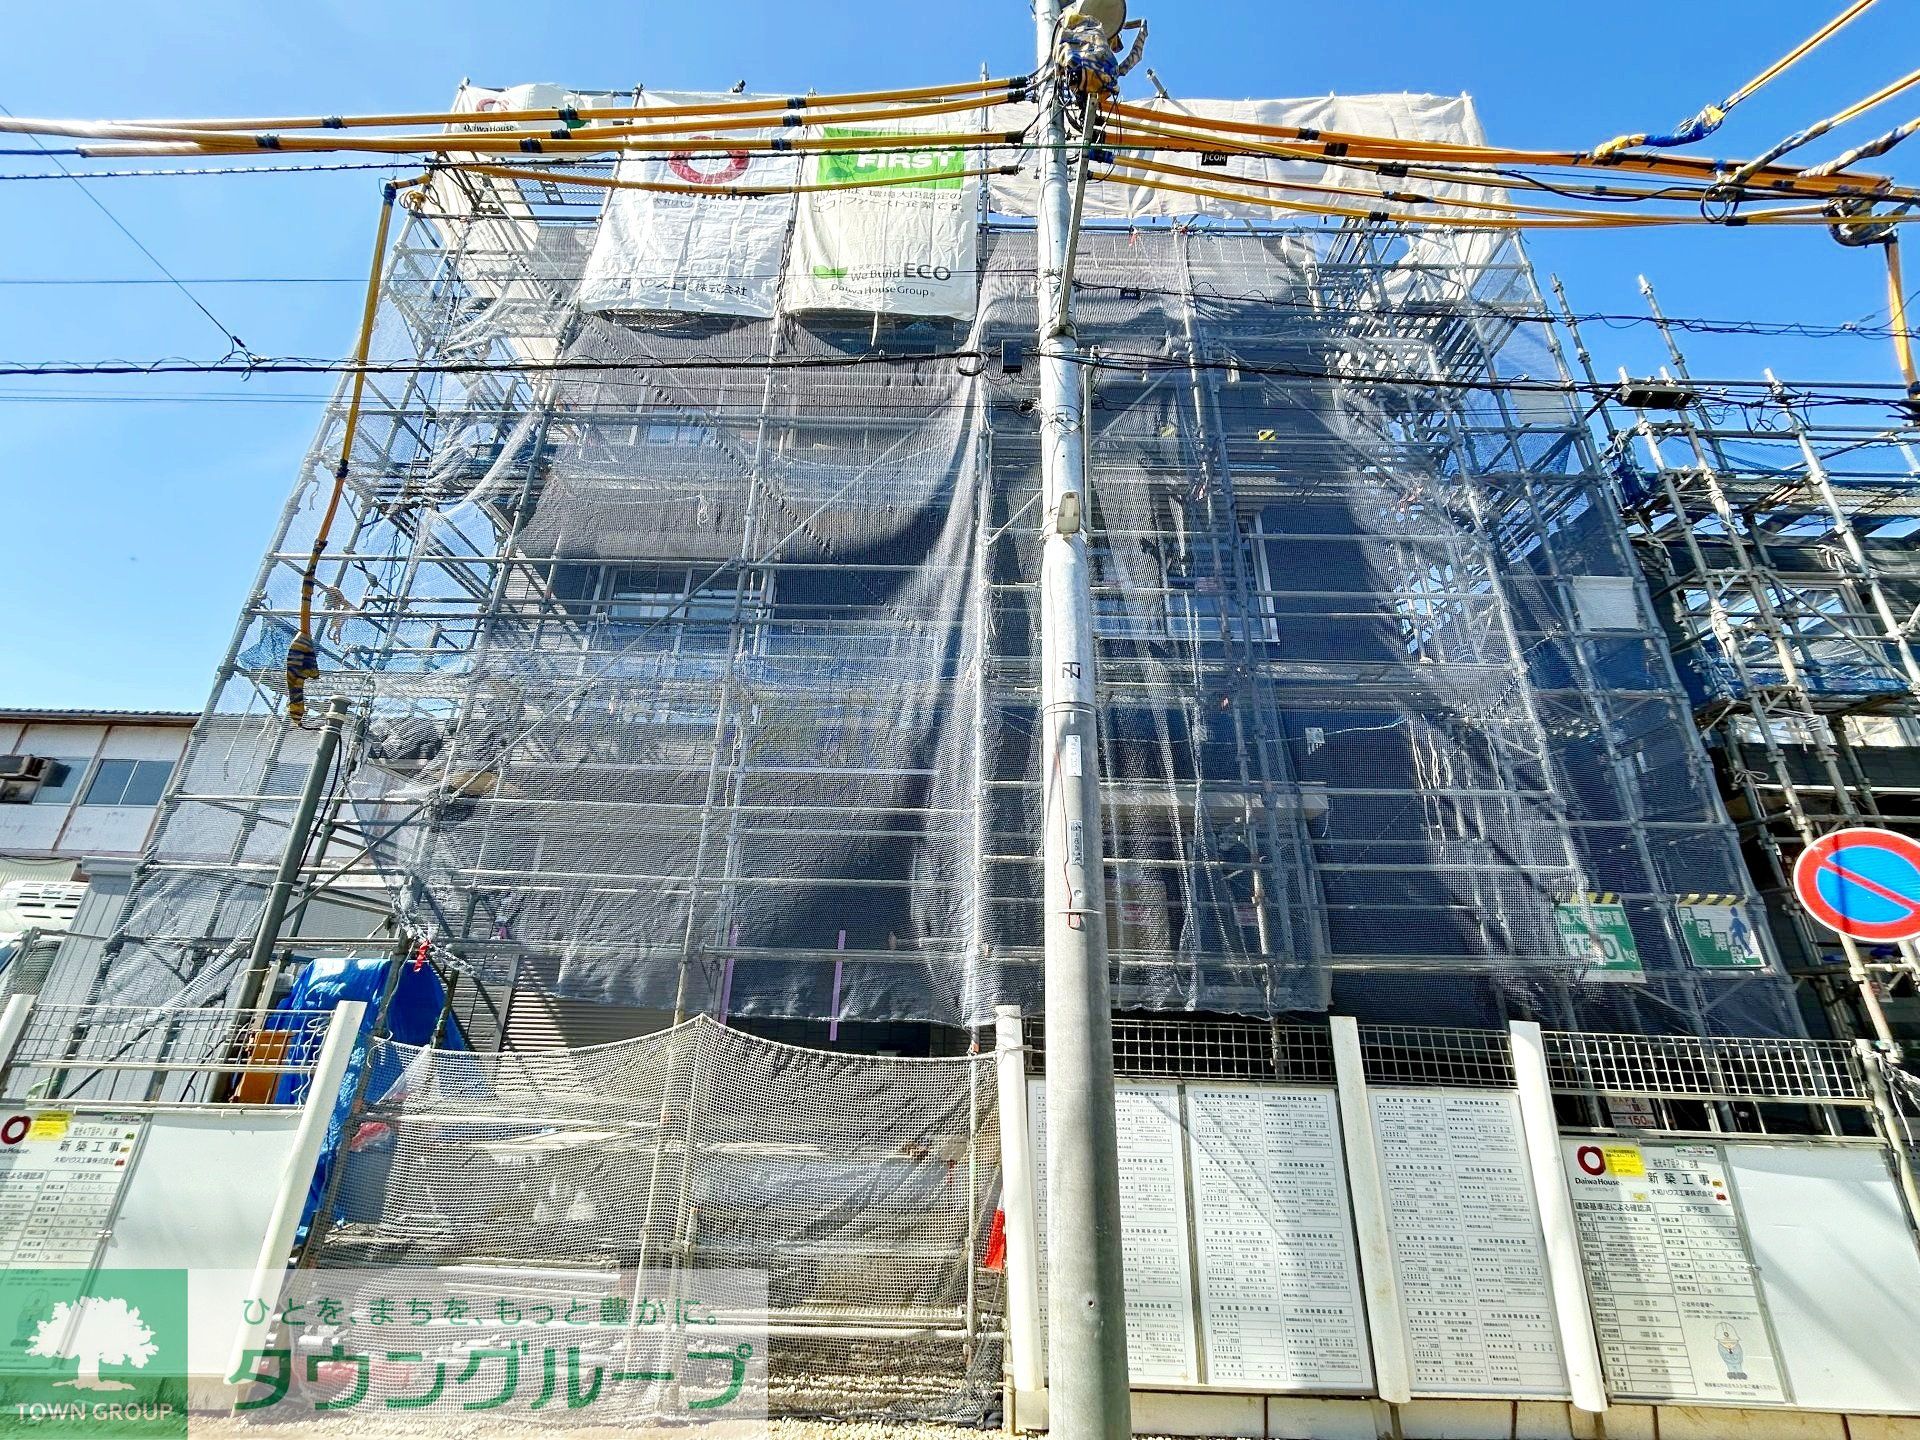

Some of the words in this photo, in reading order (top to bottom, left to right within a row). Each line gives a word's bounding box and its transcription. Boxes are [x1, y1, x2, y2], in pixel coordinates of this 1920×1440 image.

[855, 151, 958, 169] FIRST
[869, 268, 900, 279] Build
[903, 262, 952, 281] ECO
[831, 283, 863, 295] Daiwa
[864, 285, 896, 295] House
[896, 285, 930, 298] Group
[1574, 1177, 1598, 1185] Daiwa
[1598, 1178, 1620, 1186] House
[1647, 1171, 1711, 1186] 新築工事
[1650, 1188, 1714, 1198] 大和ハウス工業株式会社
[1575, 1201, 1652, 1213] 建築基準法による確認済
